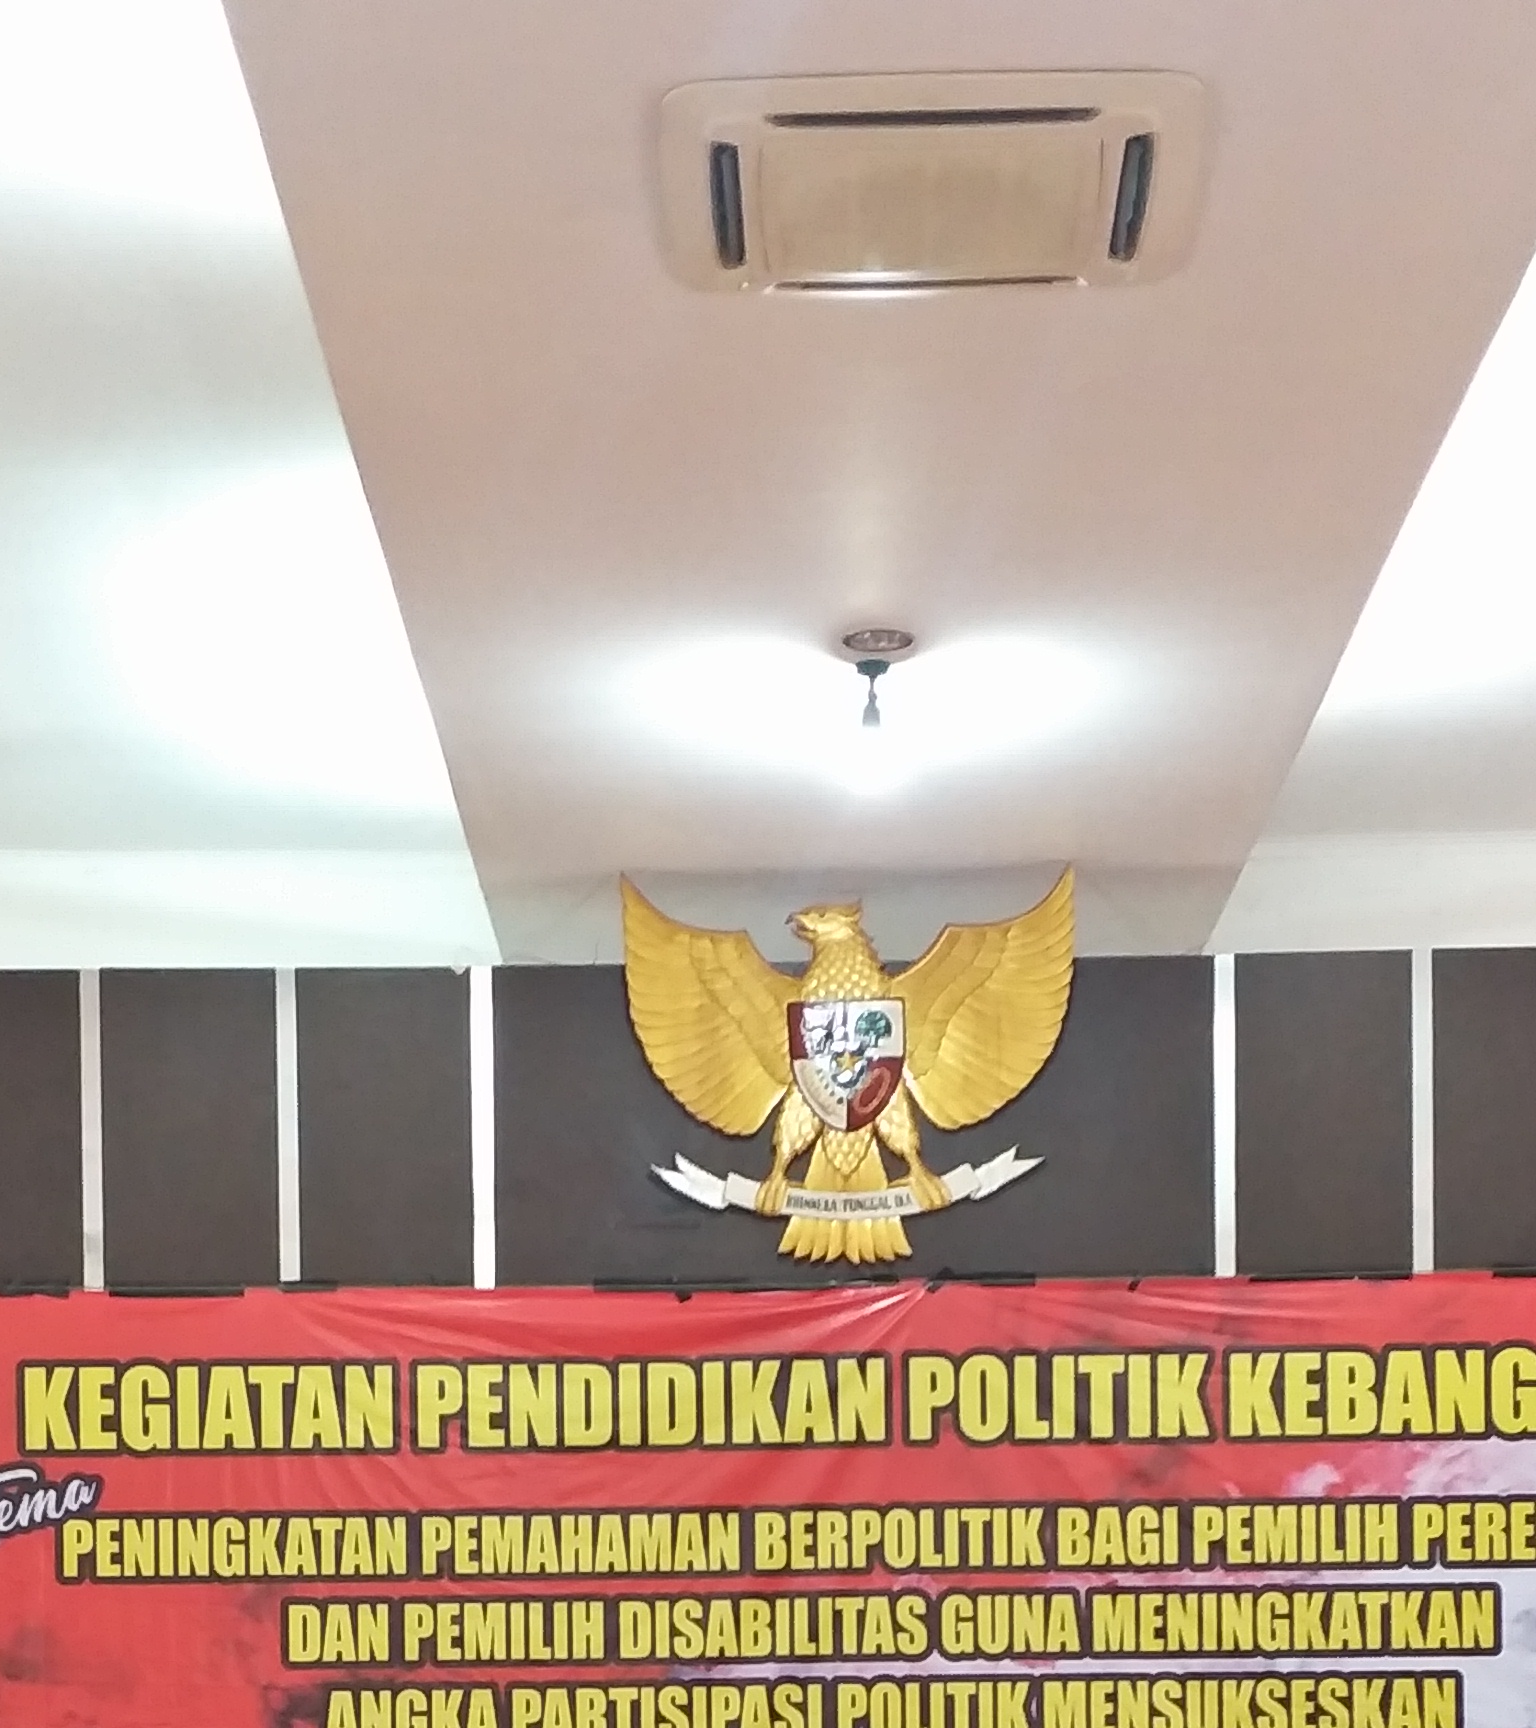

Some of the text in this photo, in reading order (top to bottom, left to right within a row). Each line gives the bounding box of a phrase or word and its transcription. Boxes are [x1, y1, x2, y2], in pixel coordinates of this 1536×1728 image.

[24, 1364, 395, 1452] KEGIATAN
[416, 1359, 885, 1448] PENDIDIKAN
[908, 1353, 1207, 1442] POLITIK
[62, 1517, 407, 1577] PENINGKATAN
[421, 1512, 741, 1575] PEMAHAMAN
[754, 1508, 1043, 1570] BERPOLITIK
[1057, 1507, 1179, 1566] BAGI
[1192, 1503, 1399, 1564] PEMILIH
[288, 1590, 1495, 1663] DAN PEMILIH DISABILITAS GUNA MENINGKATKAN
